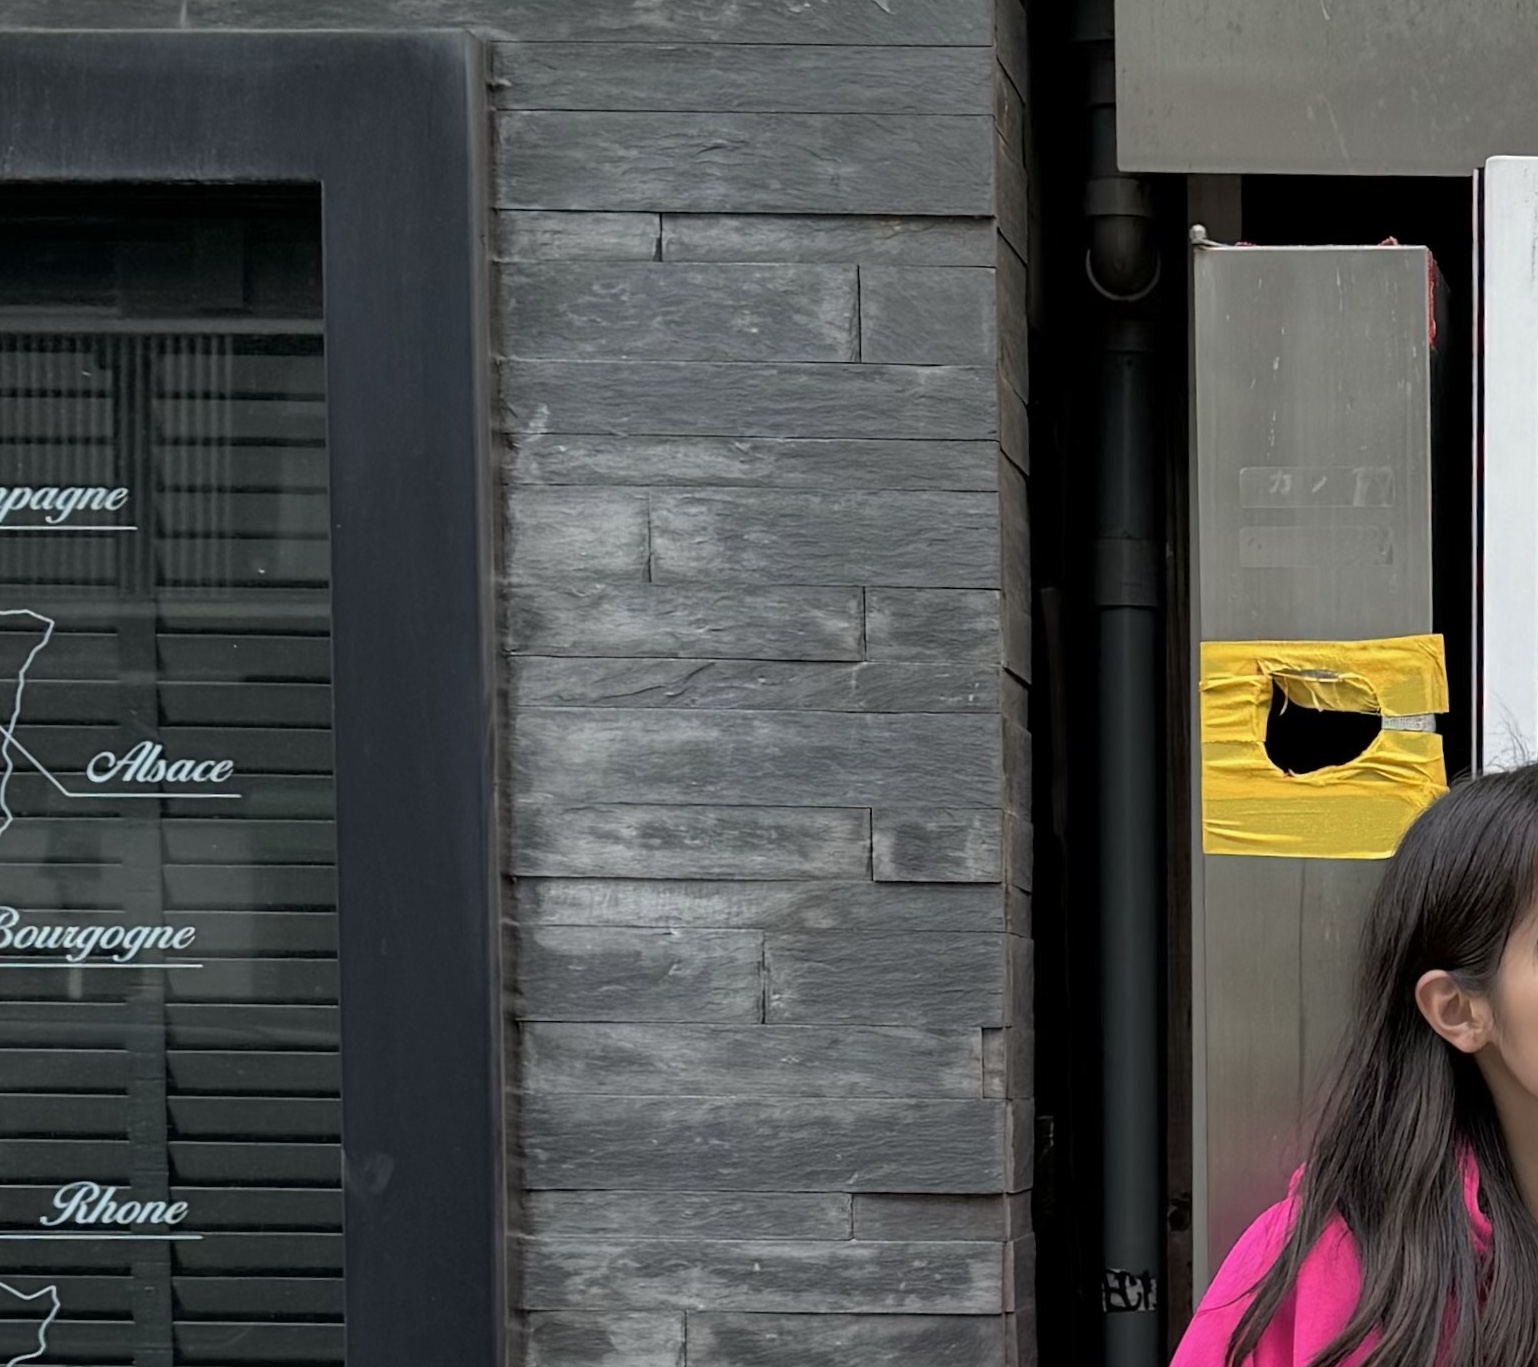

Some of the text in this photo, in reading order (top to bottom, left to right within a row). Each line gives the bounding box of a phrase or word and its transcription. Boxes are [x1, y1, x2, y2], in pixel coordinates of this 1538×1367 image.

[85, 741, 234, 784] Alsace
[0, 906, 196, 962] Bourgogne
[39, 1180, 189, 1227] Rhone
